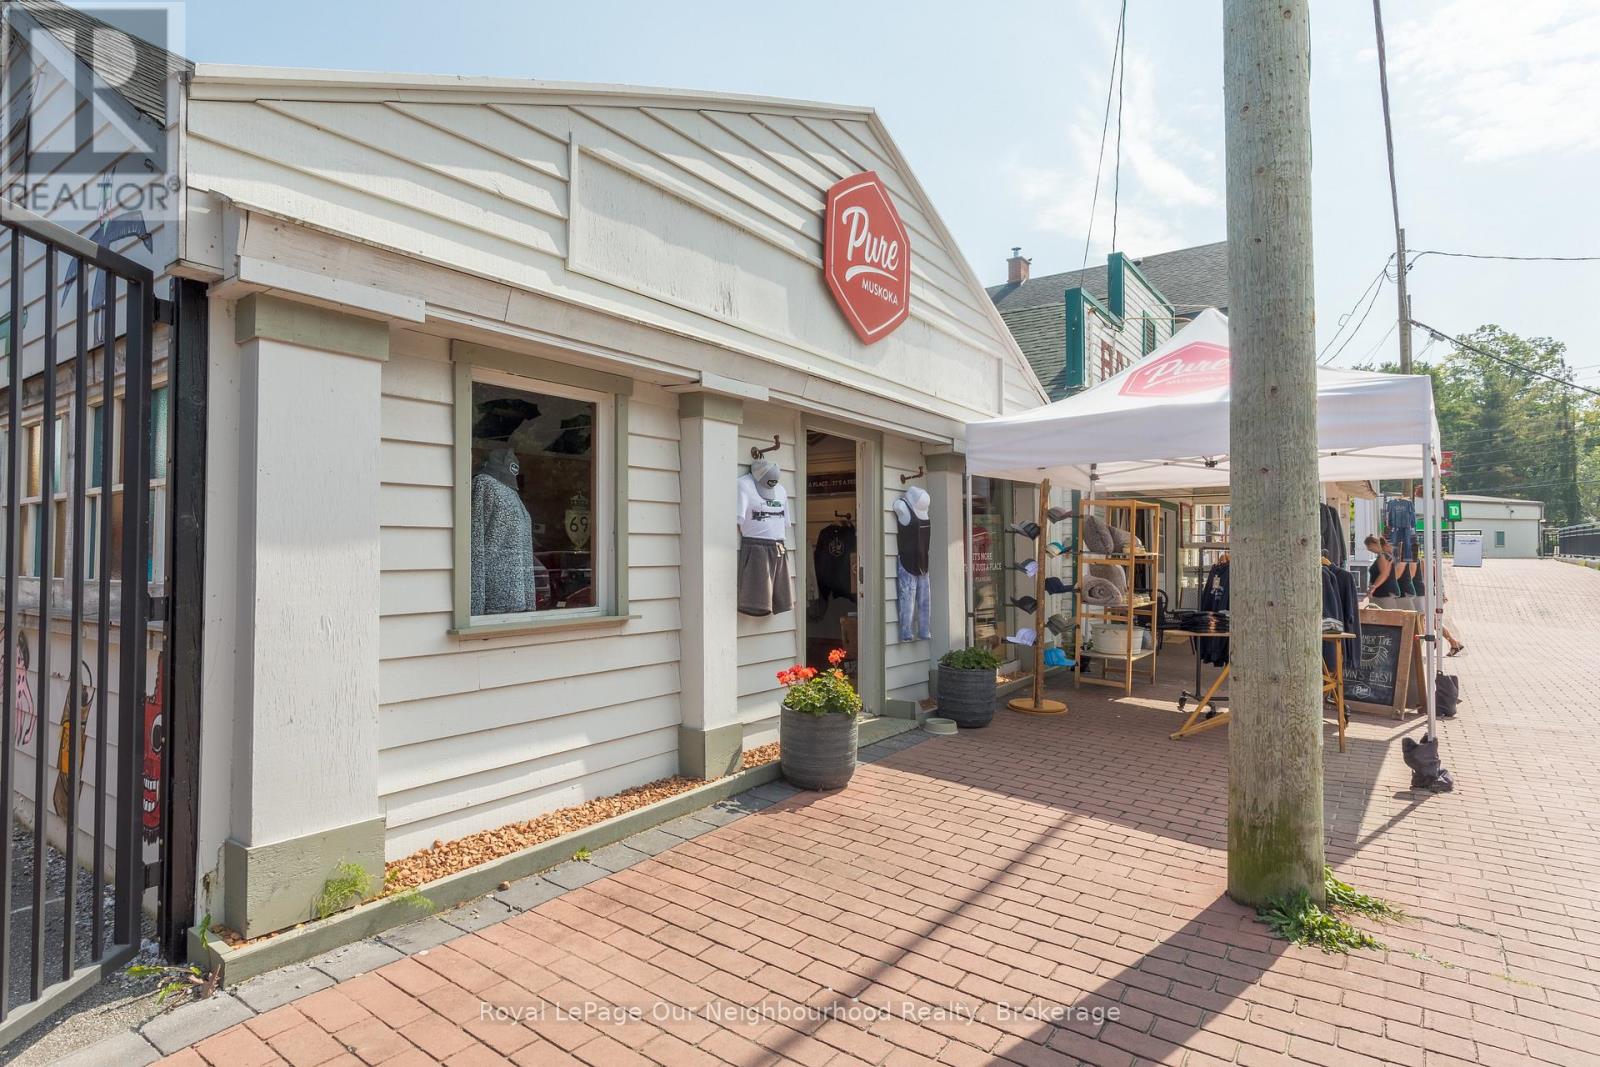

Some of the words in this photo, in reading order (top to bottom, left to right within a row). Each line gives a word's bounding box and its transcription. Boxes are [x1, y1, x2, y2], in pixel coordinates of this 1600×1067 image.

[842, 206, 899, 271] Pure
[862, 277, 899, 305] MUSKOKA
[1144, 359, 1229, 384] Pure
[1449, 505, 1460, 516] TD
[569, 516, 588, 533] 69
[981, 552, 993, 560] MORE
[1343, 669, 1365, 680] VIN'S
[1369, 671, 1393, 683] EASY!
